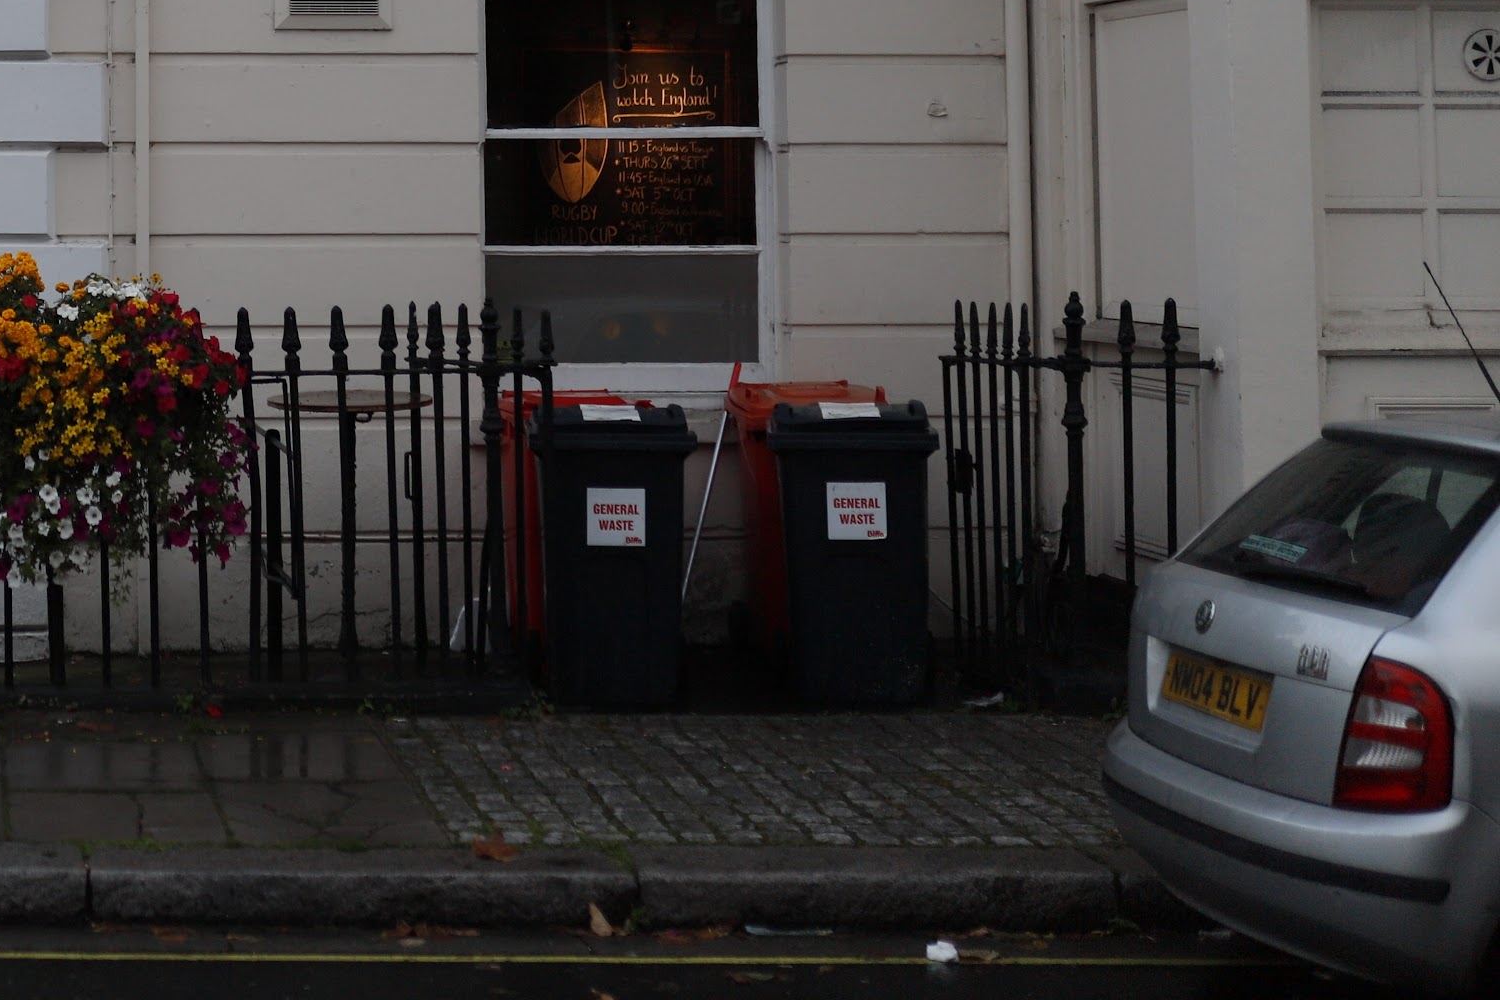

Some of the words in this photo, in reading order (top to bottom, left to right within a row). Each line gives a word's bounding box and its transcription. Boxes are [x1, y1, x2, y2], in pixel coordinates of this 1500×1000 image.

[612, 64, 650, 89] Join
[658, 72, 680, 85] us
[690, 65, 704, 86] to
[616, 88, 656, 107] watch
[623, 156, 658, 169] THURS
[681, 155, 708, 170] SEPT
[624, 186, 645, 199] SAT
[673, 188, 696, 201] OCT
[551, 204, 598, 222] RUGBY
[593, 503, 639, 515] GENERAL
[833, 498, 881, 509] GENERAL
[599, 519, 634, 531] WASTE
[839, 514, 875, 525] WASTE
[1217, 675, 1262, 720] BLV
